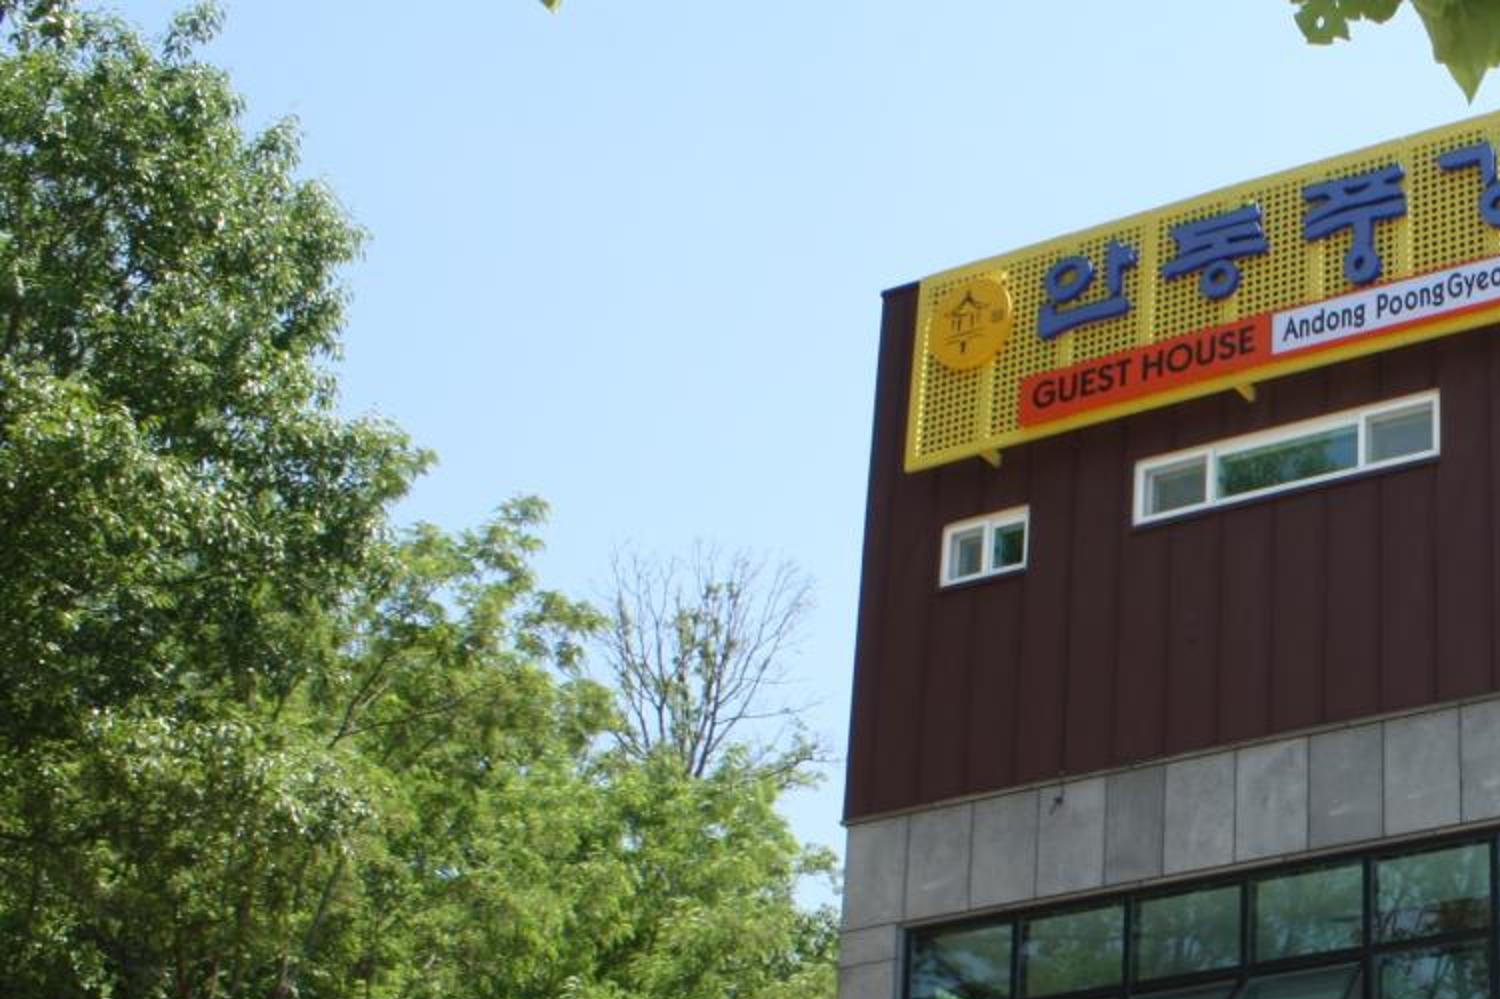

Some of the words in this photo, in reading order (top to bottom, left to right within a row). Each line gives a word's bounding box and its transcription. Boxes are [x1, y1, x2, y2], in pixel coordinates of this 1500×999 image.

[1282, 303, 1365, 342] Andong
[1032, 359, 1130, 409] GUEST
[1141, 325, 1255, 381] HOUSE
